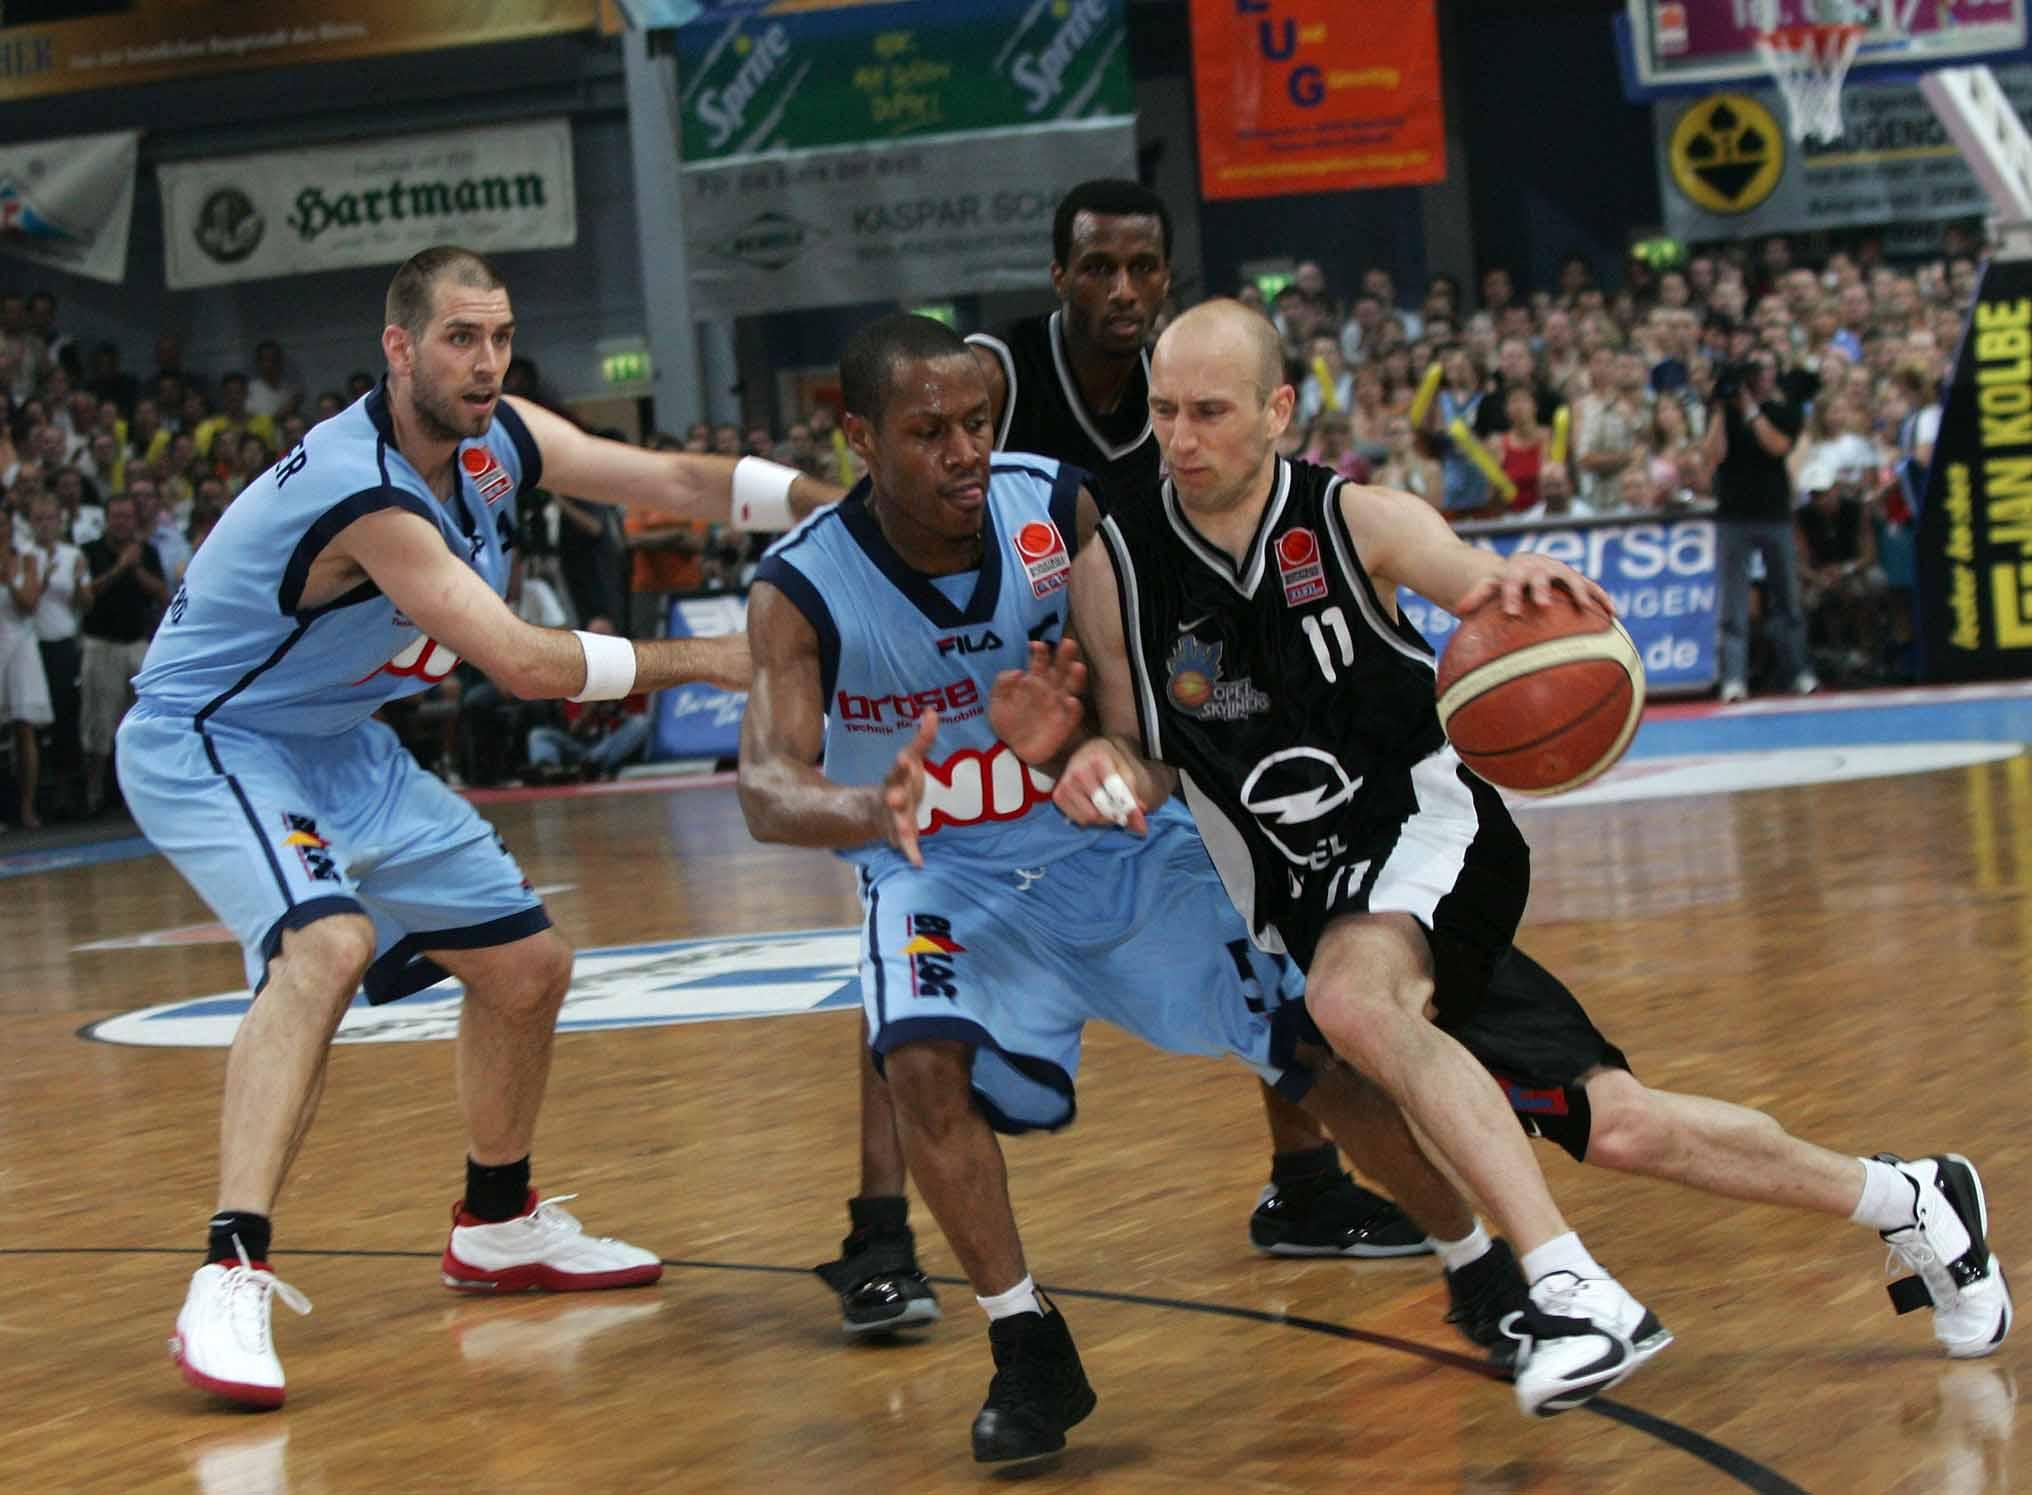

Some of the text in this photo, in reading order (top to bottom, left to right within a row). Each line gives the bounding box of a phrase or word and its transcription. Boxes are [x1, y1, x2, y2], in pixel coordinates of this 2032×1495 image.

[698, 24, 789, 148] Sprite
[287, 171, 547, 242] Hartmann
[1975, 297, 2032, 448] KOLBE
[935, 629, 1004, 657] FILA
[1301, 606, 1354, 684] 11
[837, 675, 978, 722] brose
